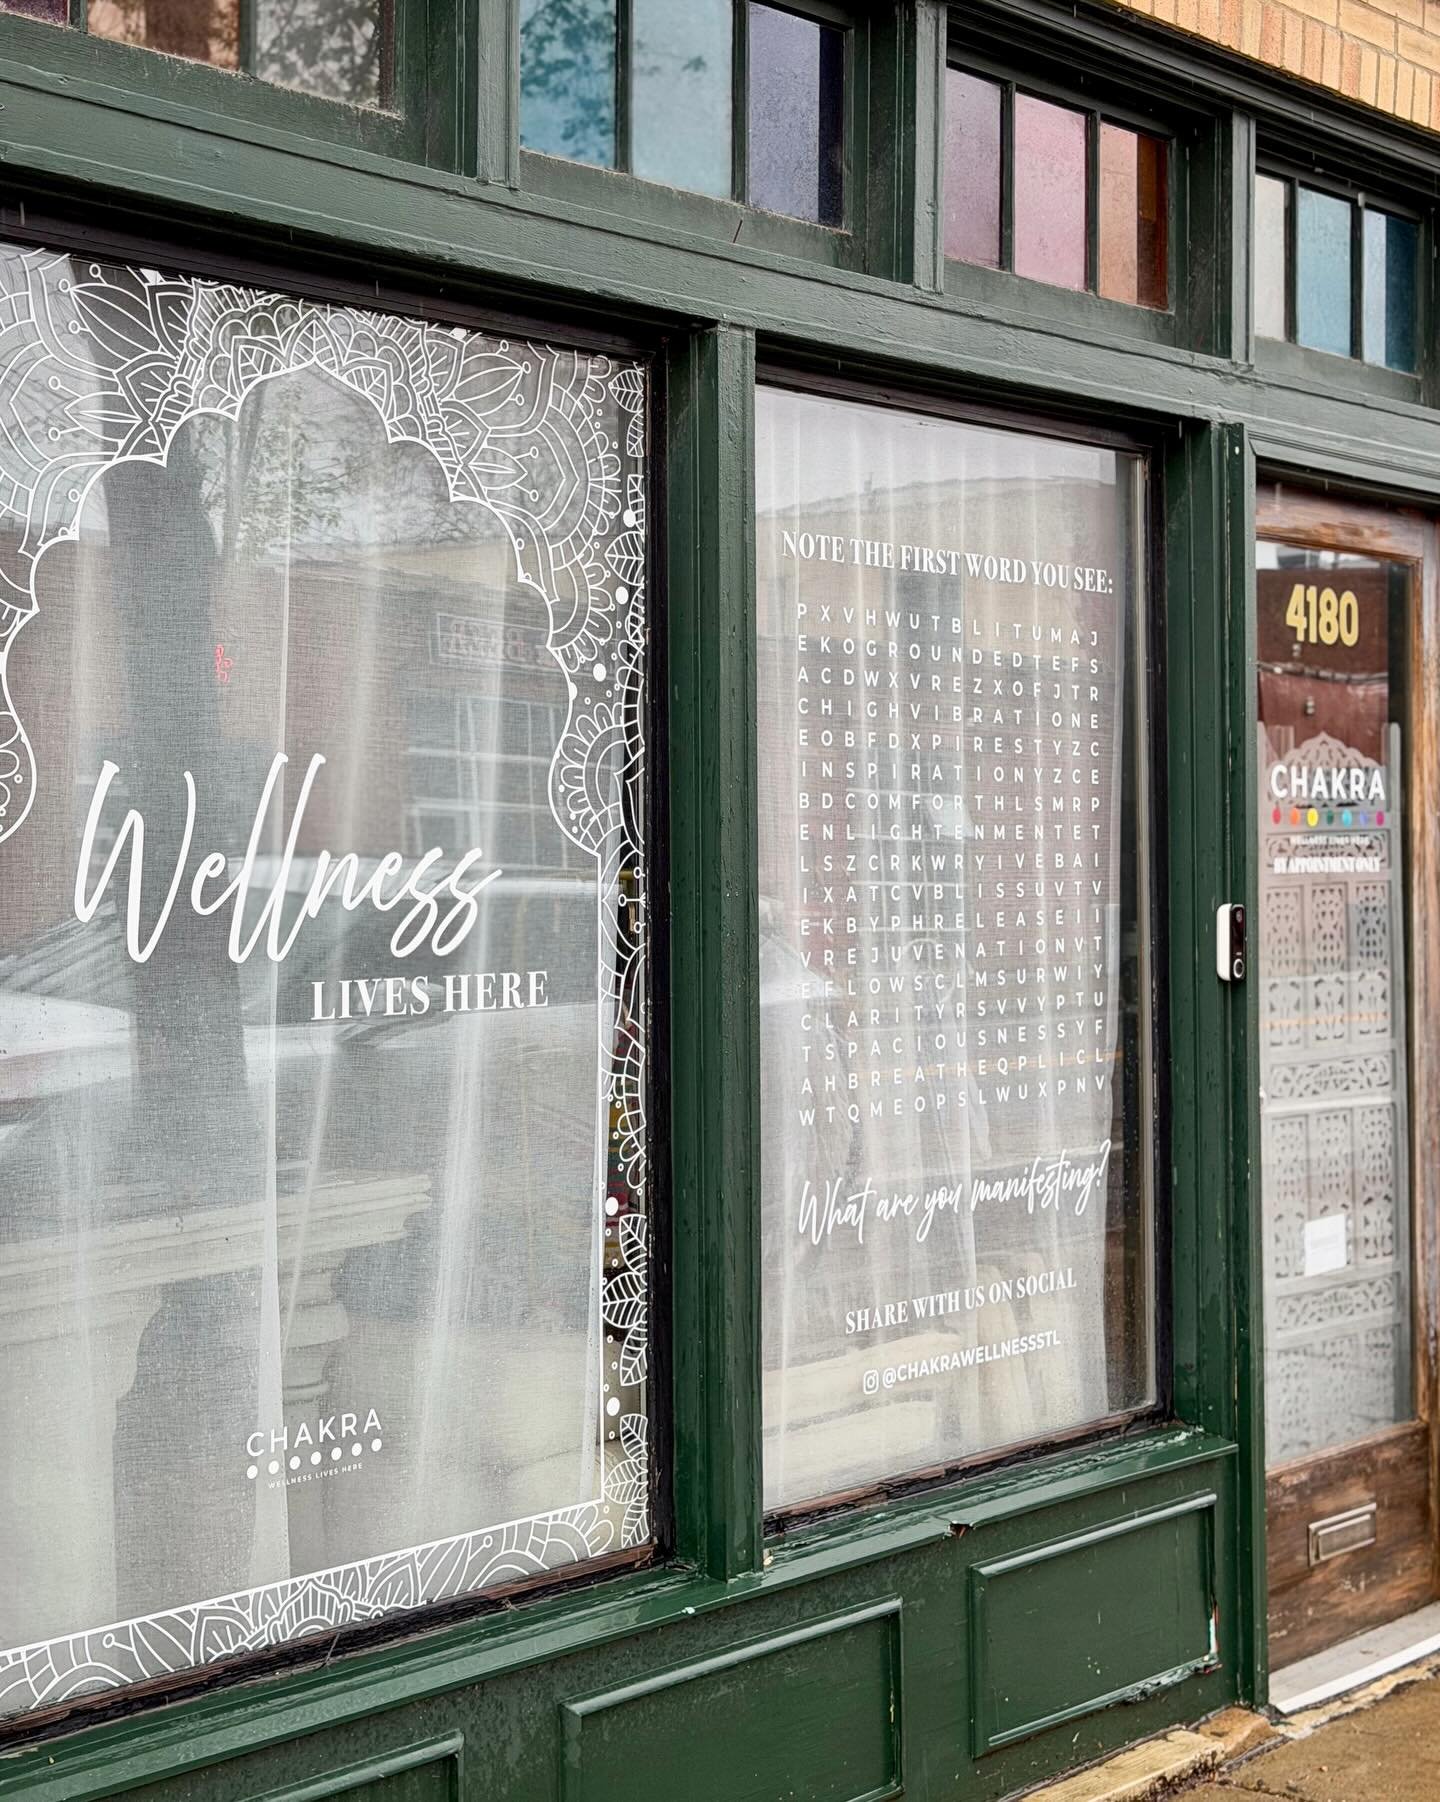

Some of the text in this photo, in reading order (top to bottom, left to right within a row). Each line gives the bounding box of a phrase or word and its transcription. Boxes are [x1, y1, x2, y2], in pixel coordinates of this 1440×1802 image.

[782, 530, 1114, 594] NOTE THE FIRST WORD YOU SEE:
[1286, 584, 1359, 647] 4180
[1270, 764, 1386, 801] CHAKRA
[74, 752, 502, 964] Wellness
[310, 970, 549, 1021] LIVES HERE
[799, 1138, 1112, 1245] What are you manifesting?
[845, 1267, 1077, 1335] SHARE WITH US ON SOCIAL
[882, 1330, 1061, 1389] @CHAKRAWELLNESSSTL
[247, 1408, 382, 1457] CHAKRA
[315, 1467, 338, 1480] LIVES
